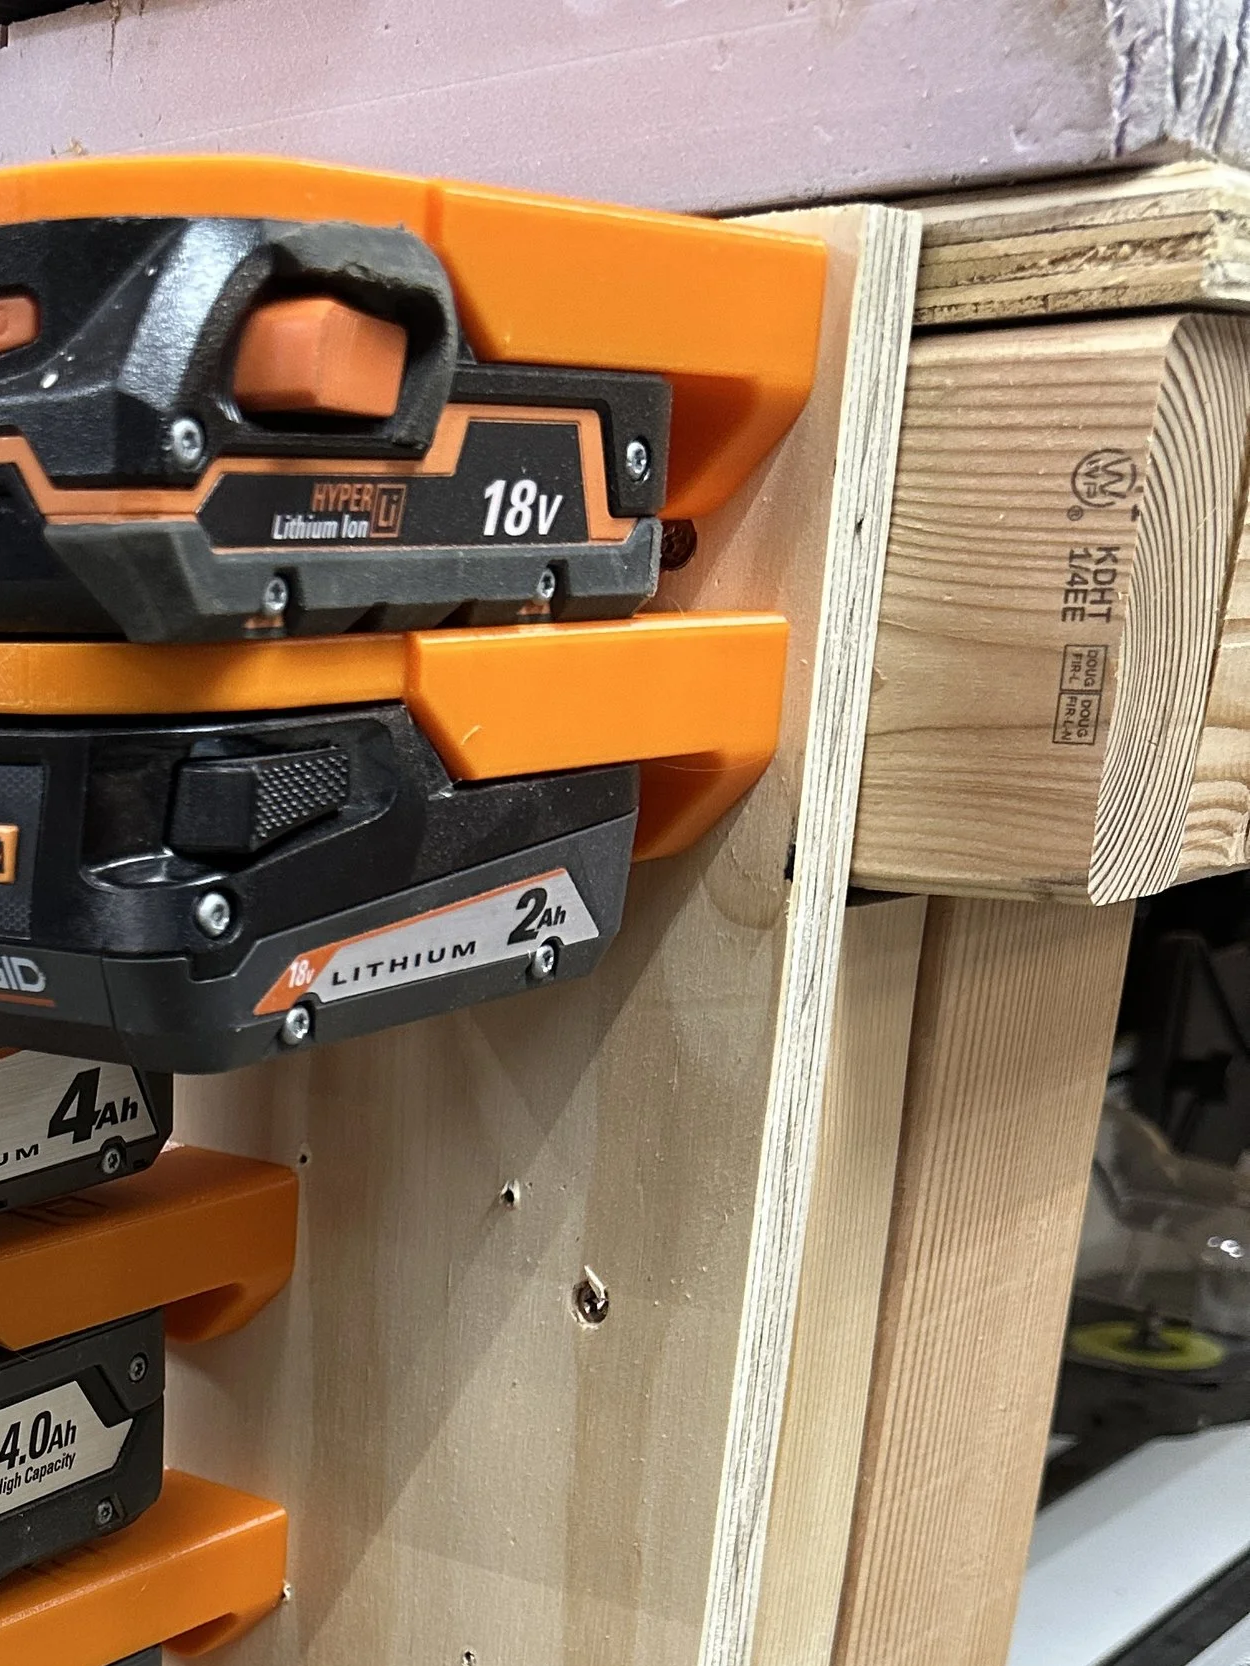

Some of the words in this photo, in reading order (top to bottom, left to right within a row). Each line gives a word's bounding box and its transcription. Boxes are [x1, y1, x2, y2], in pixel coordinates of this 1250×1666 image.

[311, 483, 375, 512] HYPER
[271, 514, 339, 540] Lithium
[341, 513, 369, 538] Ion
[1061, 548, 1092, 623] 1/4EE
[1088, 546, 1120, 624] KDHT
[1084, 650, 1099, 688] DOUG
[1076, 699, 1093, 738] DOUG
[507, 887, 567, 946] 2Ah
[332, 940, 478, 987] LITHIUM
[47, 1066, 139, 1145] 4Ah
[24, 1450, 77, 1489] Capacity
